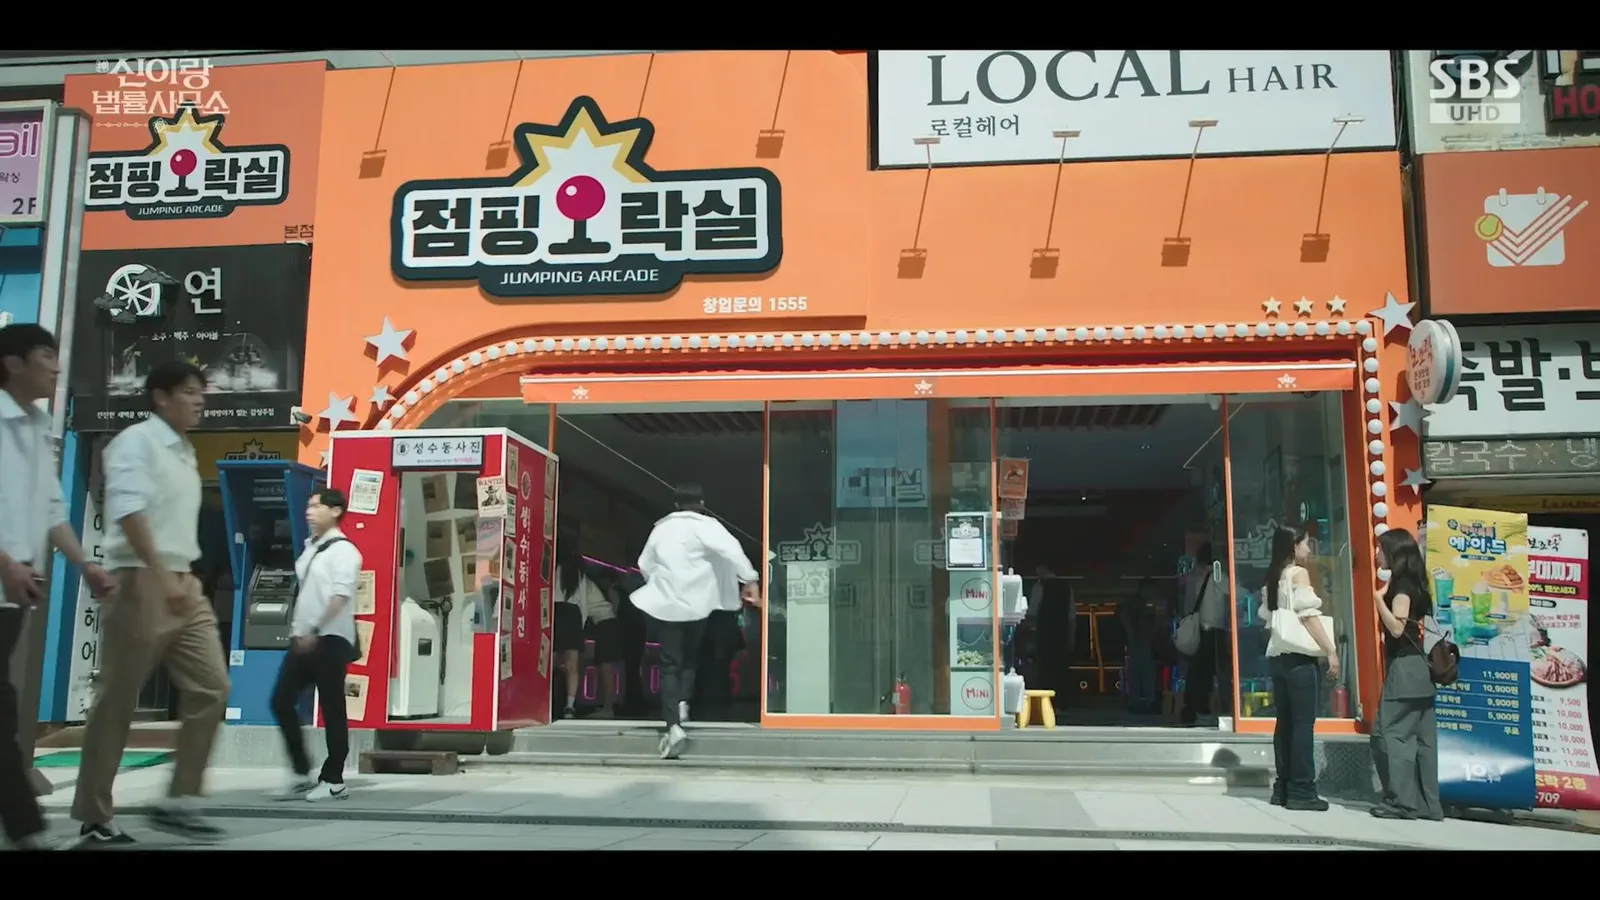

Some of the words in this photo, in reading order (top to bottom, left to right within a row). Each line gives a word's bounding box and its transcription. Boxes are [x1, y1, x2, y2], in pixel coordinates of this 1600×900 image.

[927, 49, 1211, 107] LOCAL
[1226, 62, 1338, 94] HAIR
[929, 114, 1021, 139] 로컬헤어
[137, 205, 183, 216] JUMPING
[185, 203, 224, 214] ARCADE
[500, 270, 583, 285] JUMPING
[588, 268, 659, 283] ARCADE
[184, 267, 223, 315] 연
[702, 296, 762, 313] 창업문의
[768, 295, 808, 312] 1555
[1426, 440, 1527, 472] 칼국수
